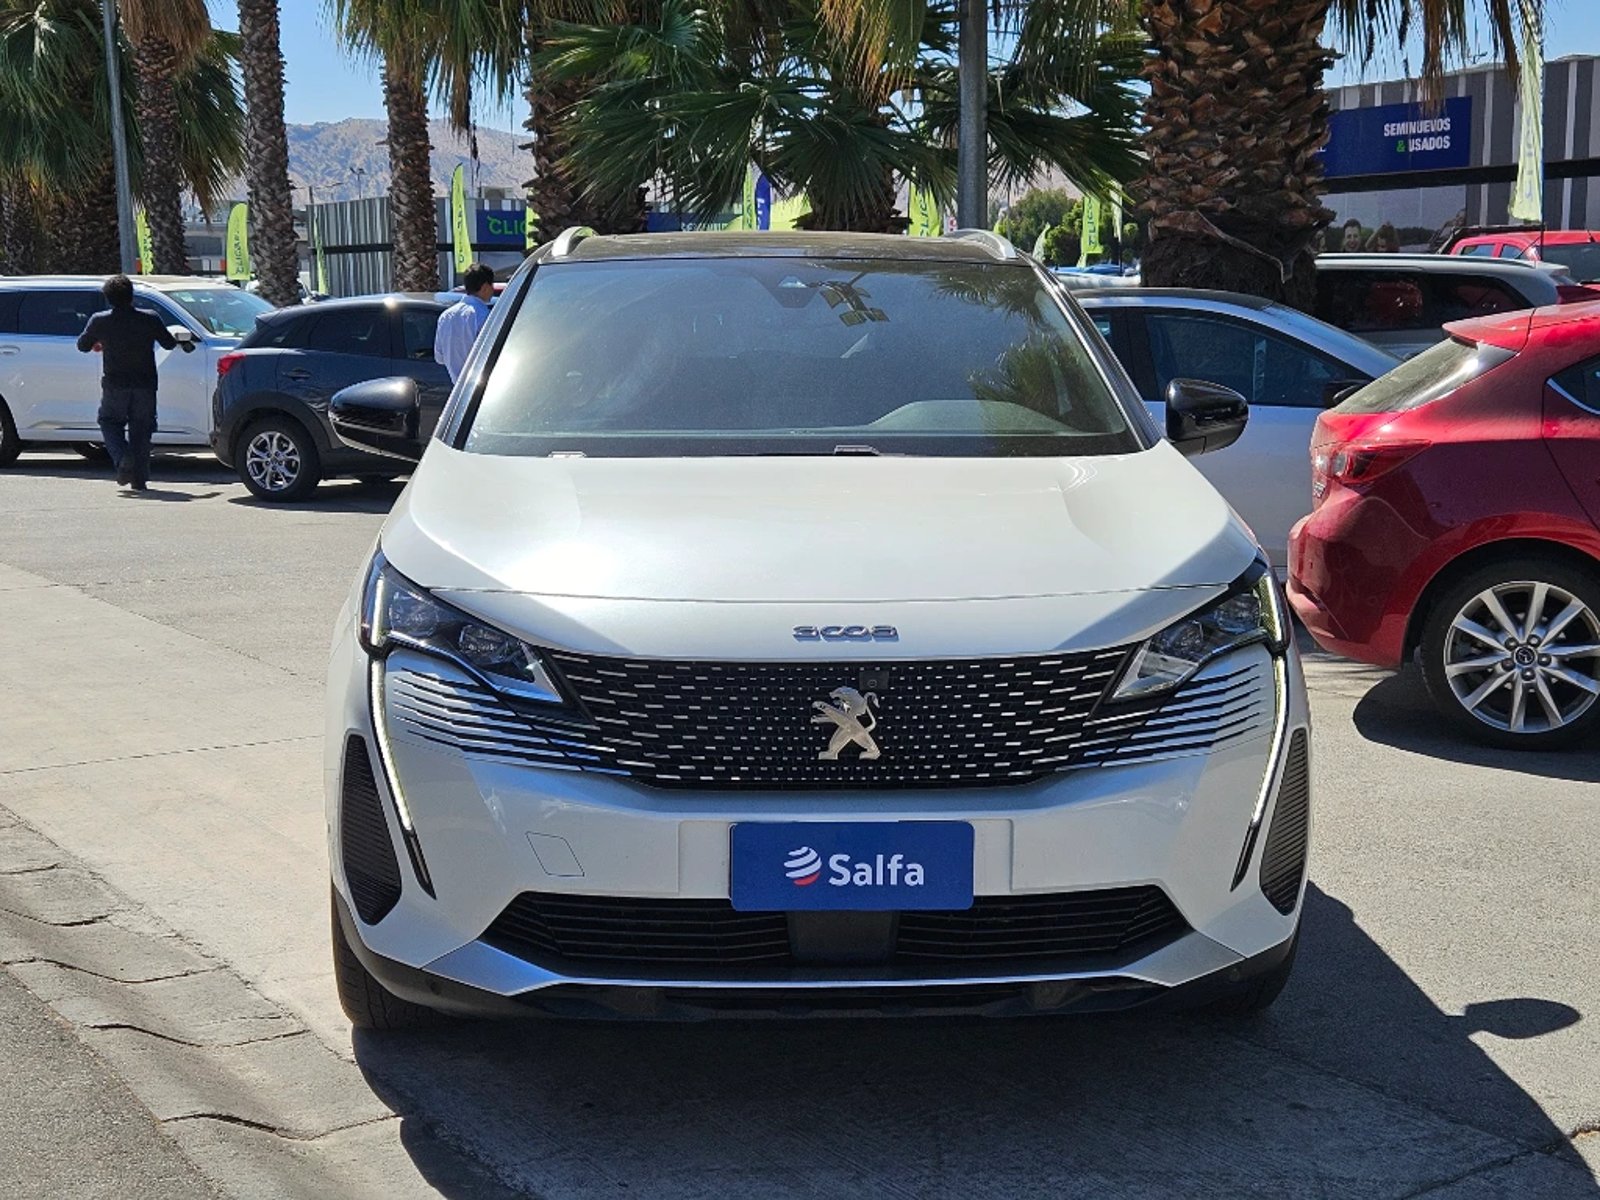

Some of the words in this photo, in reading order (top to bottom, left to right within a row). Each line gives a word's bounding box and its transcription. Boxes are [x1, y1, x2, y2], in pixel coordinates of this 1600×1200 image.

[1383, 117, 1451, 137] SEMINUEVOS
[1396, 140, 1405, 152] &
[1408, 135, 1451, 152] USADOS
[828, 854, 925, 886] Salfa
